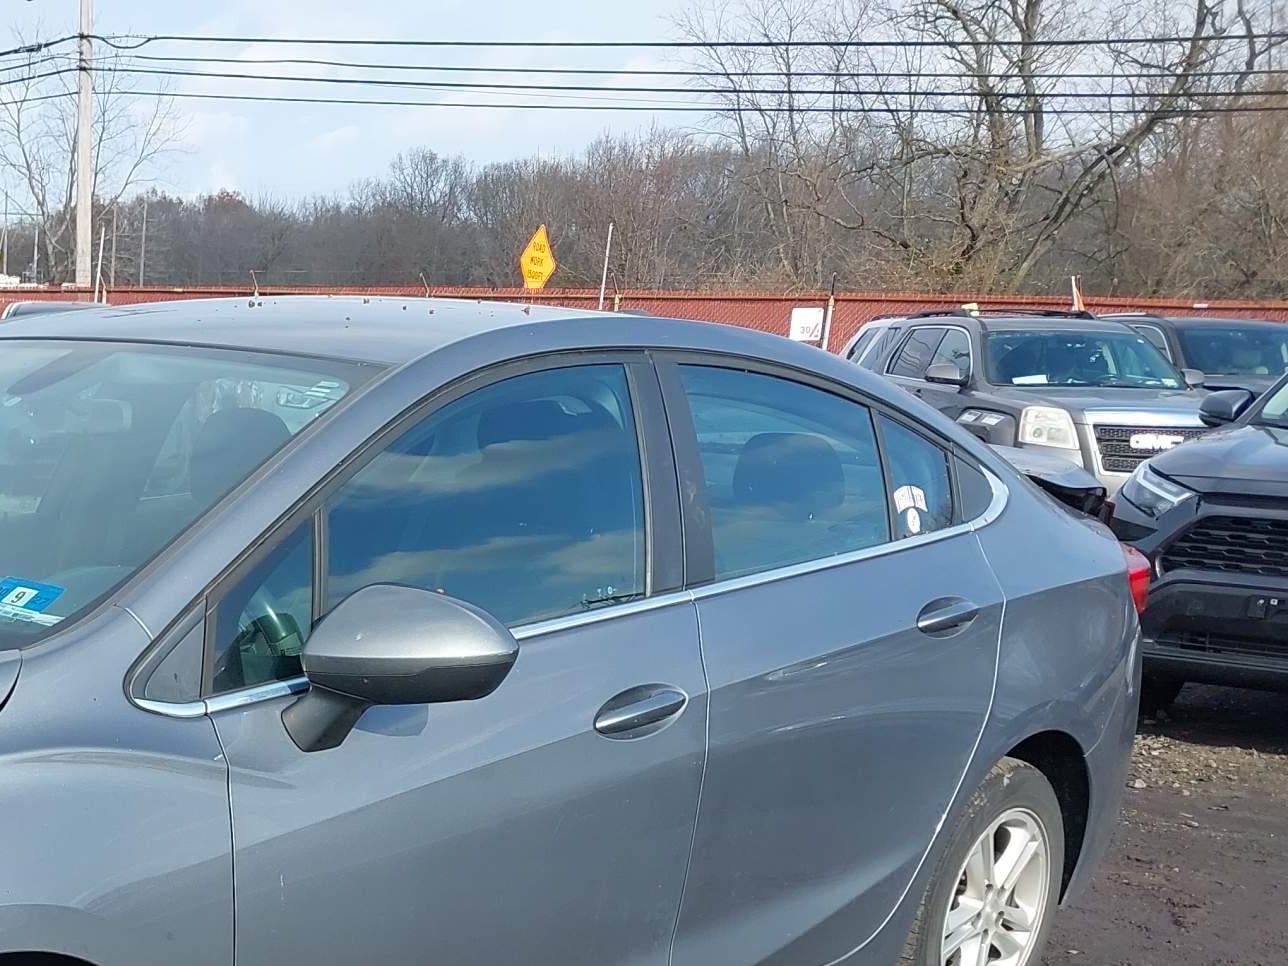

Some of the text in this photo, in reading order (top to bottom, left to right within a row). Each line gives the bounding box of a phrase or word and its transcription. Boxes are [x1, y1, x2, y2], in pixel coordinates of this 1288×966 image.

[533, 241, 546, 254] ROAD
[530, 256, 544, 267] WORK
[1129, 433, 1185, 450] GMC
[10, 590, 26, 604] 9
